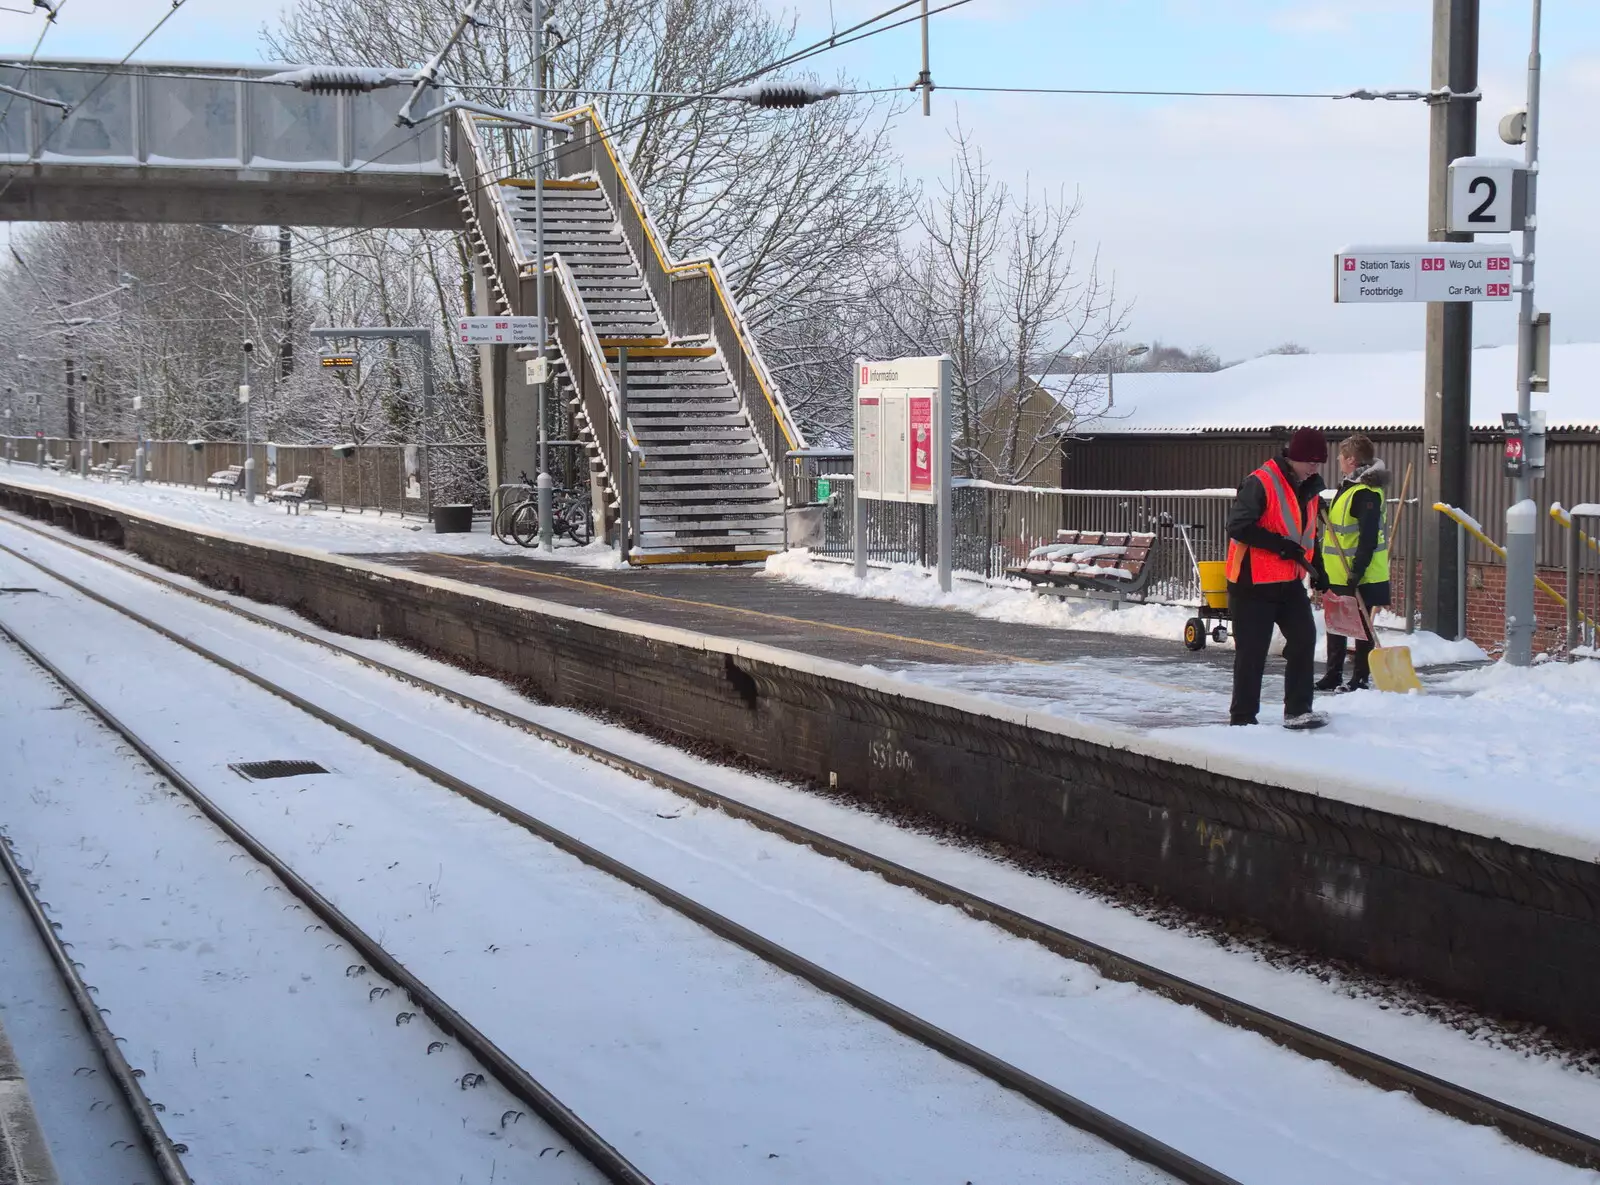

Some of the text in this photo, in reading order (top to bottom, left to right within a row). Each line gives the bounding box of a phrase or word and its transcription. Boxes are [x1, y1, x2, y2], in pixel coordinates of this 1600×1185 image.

[1468, 176, 1497, 222] 2
[1360, 260, 1411, 270] Station Taxis
[1449, 259, 1482, 271] Way Out
[1360, 274, 1379, 283] Over
[1360, 286, 1404, 297] Footbridge
[1448, 285, 1482, 295] Car Park
[870, 369, 898, 382] Information
